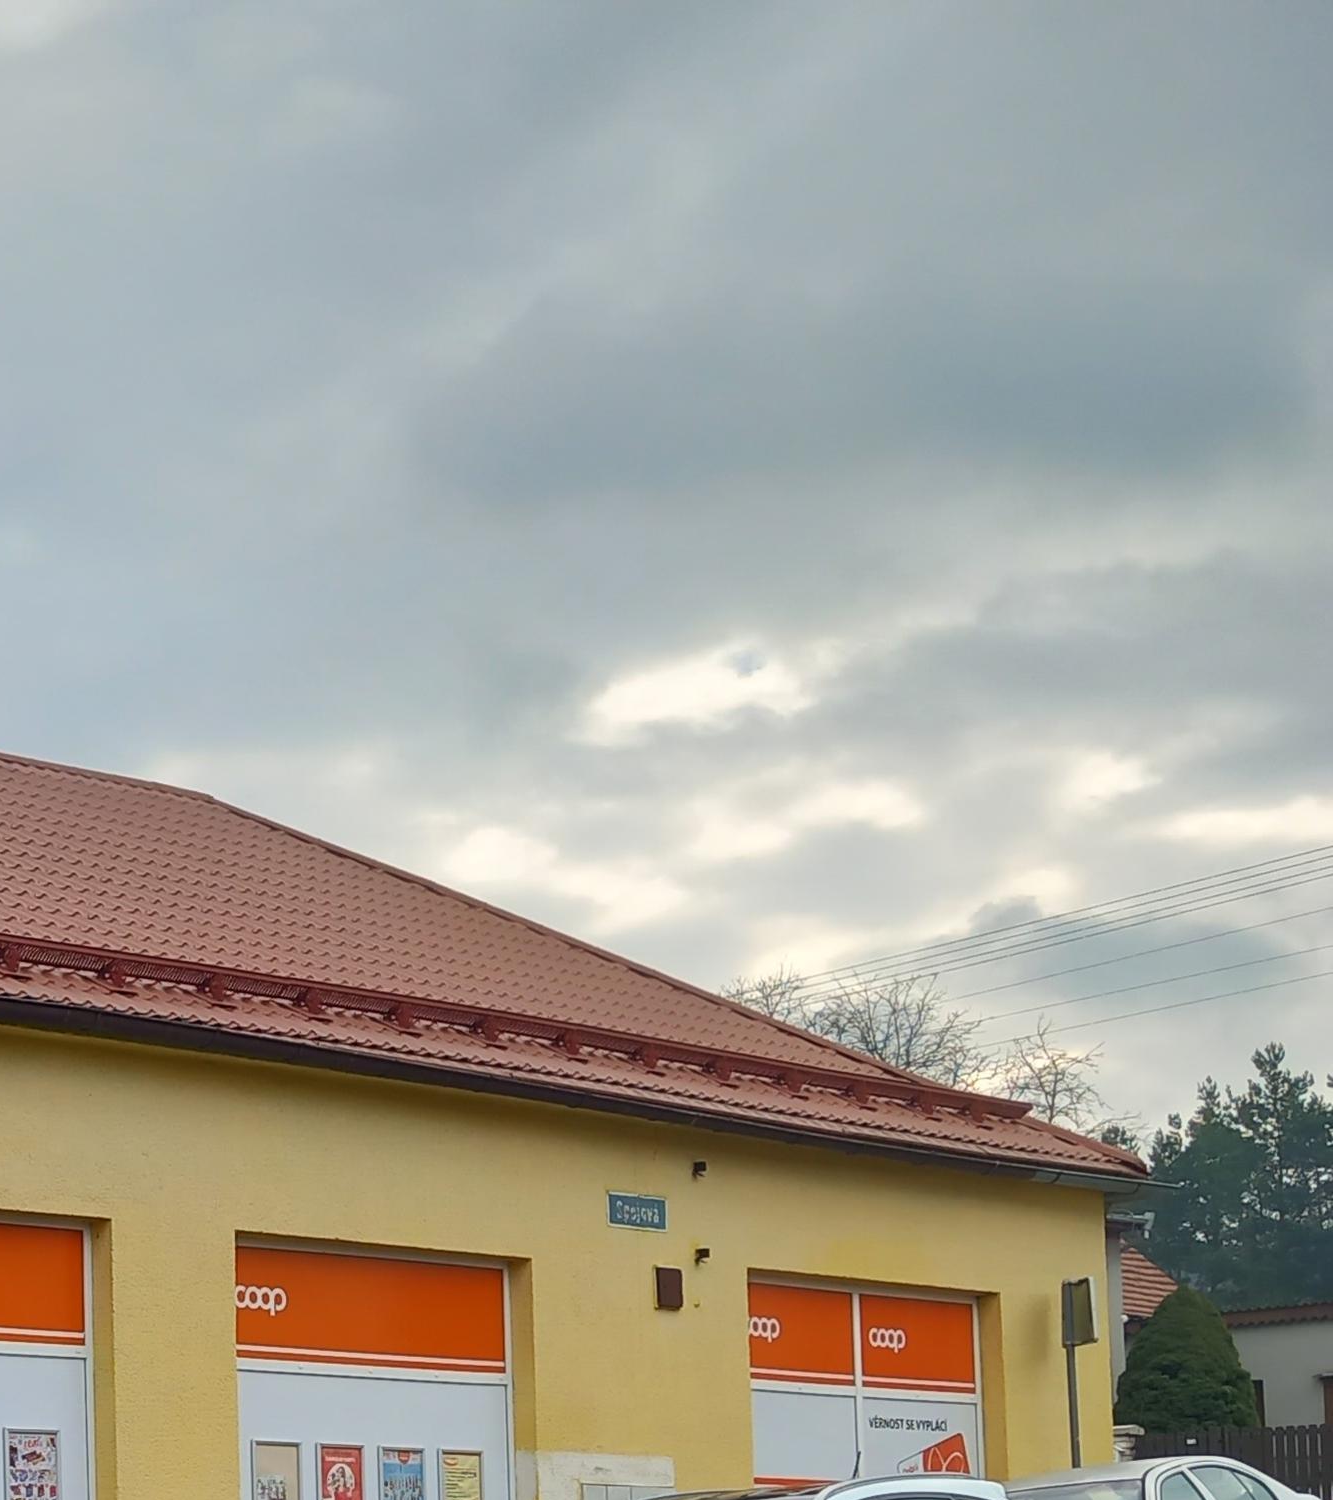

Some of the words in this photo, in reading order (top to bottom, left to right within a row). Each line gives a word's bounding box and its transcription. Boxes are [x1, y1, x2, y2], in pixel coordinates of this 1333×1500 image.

[235, 1285, 287, 1316] coop
[749, 1316, 780, 1343] oop
[868, 1327, 906, 1353] coop
[905, 1419, 916, 1431] SE
